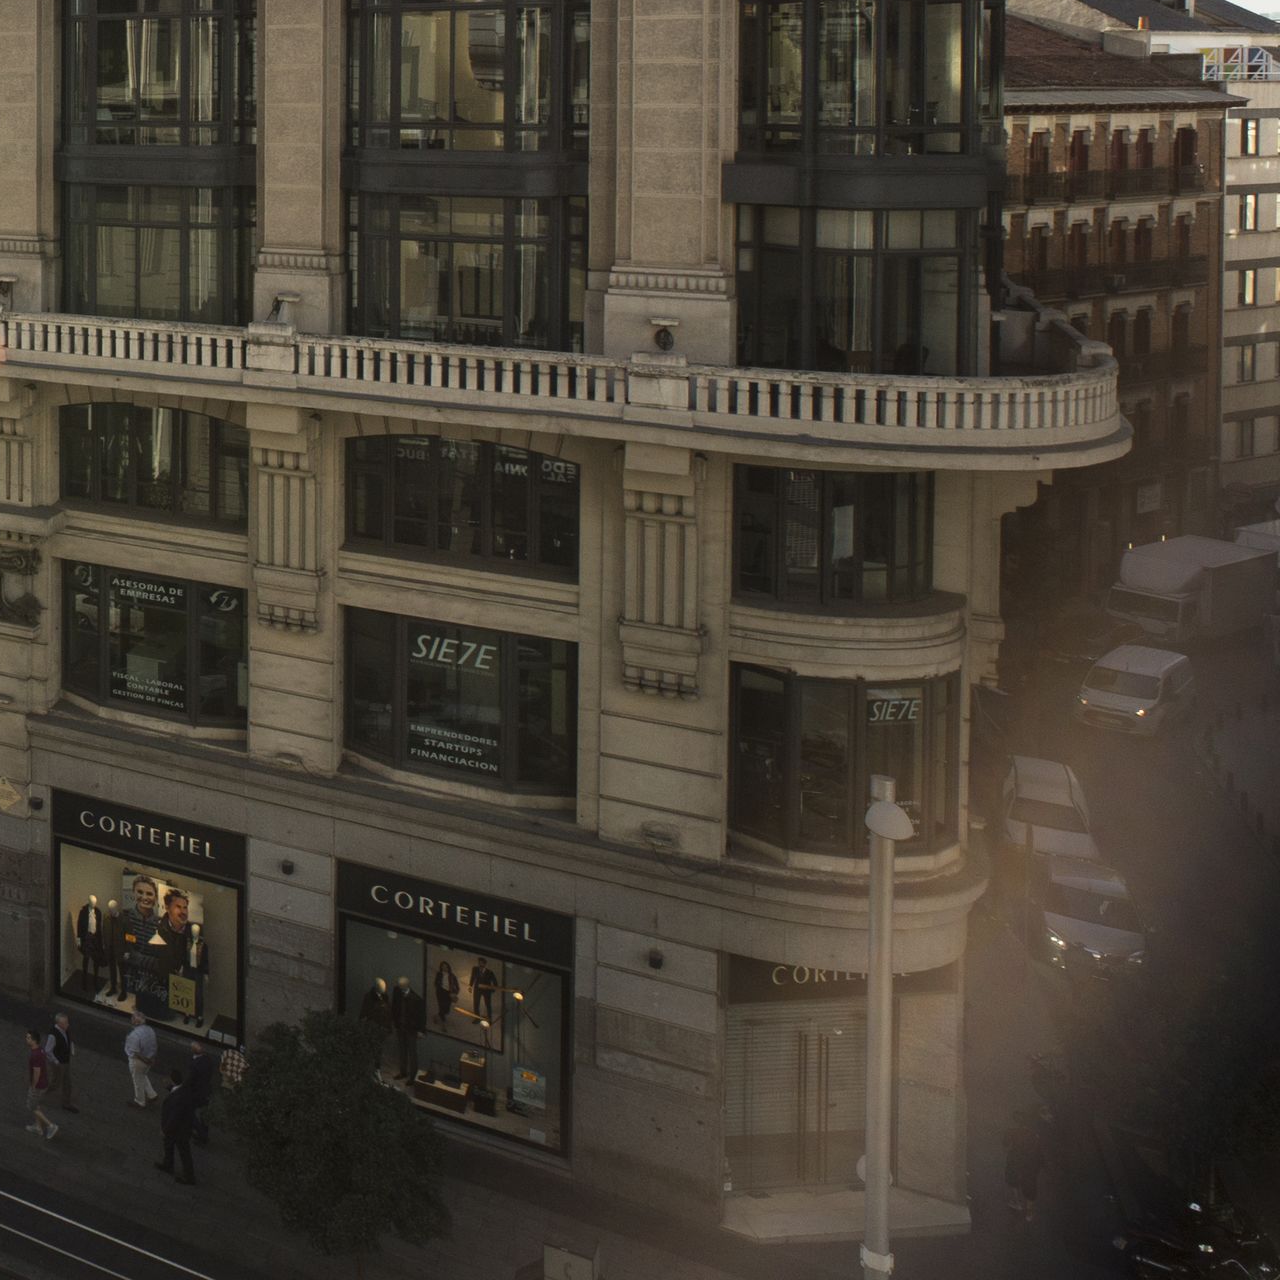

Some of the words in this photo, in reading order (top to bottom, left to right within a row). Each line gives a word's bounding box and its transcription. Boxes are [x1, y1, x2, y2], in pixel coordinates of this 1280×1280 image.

[112, 577, 166, 594] ASESORIA
[169, 586, 184, 597] DE
[120, 589, 176, 605] EMPRESAS
[412, 634, 497, 669] SIE7E
[112, 671, 140, 682] FISCAL
[146, 677, 185, 691] LABORAL
[126, 681, 169, 696] CONTABLE
[112, 688, 144, 701] GESTION
[145, 694, 156, 702] DE
[157, 696, 185, 709] FINCAS
[869, 699, 922, 721] SIE7E
[410, 724, 498, 746] EMPRENDEDORES
[424, 738, 483, 756] STARTUPS
[410, 748, 498, 772] FINANCIACION
[79, 810, 217, 860] CORTEFIEL
[371, 885, 537, 943] CORTEFIEL
